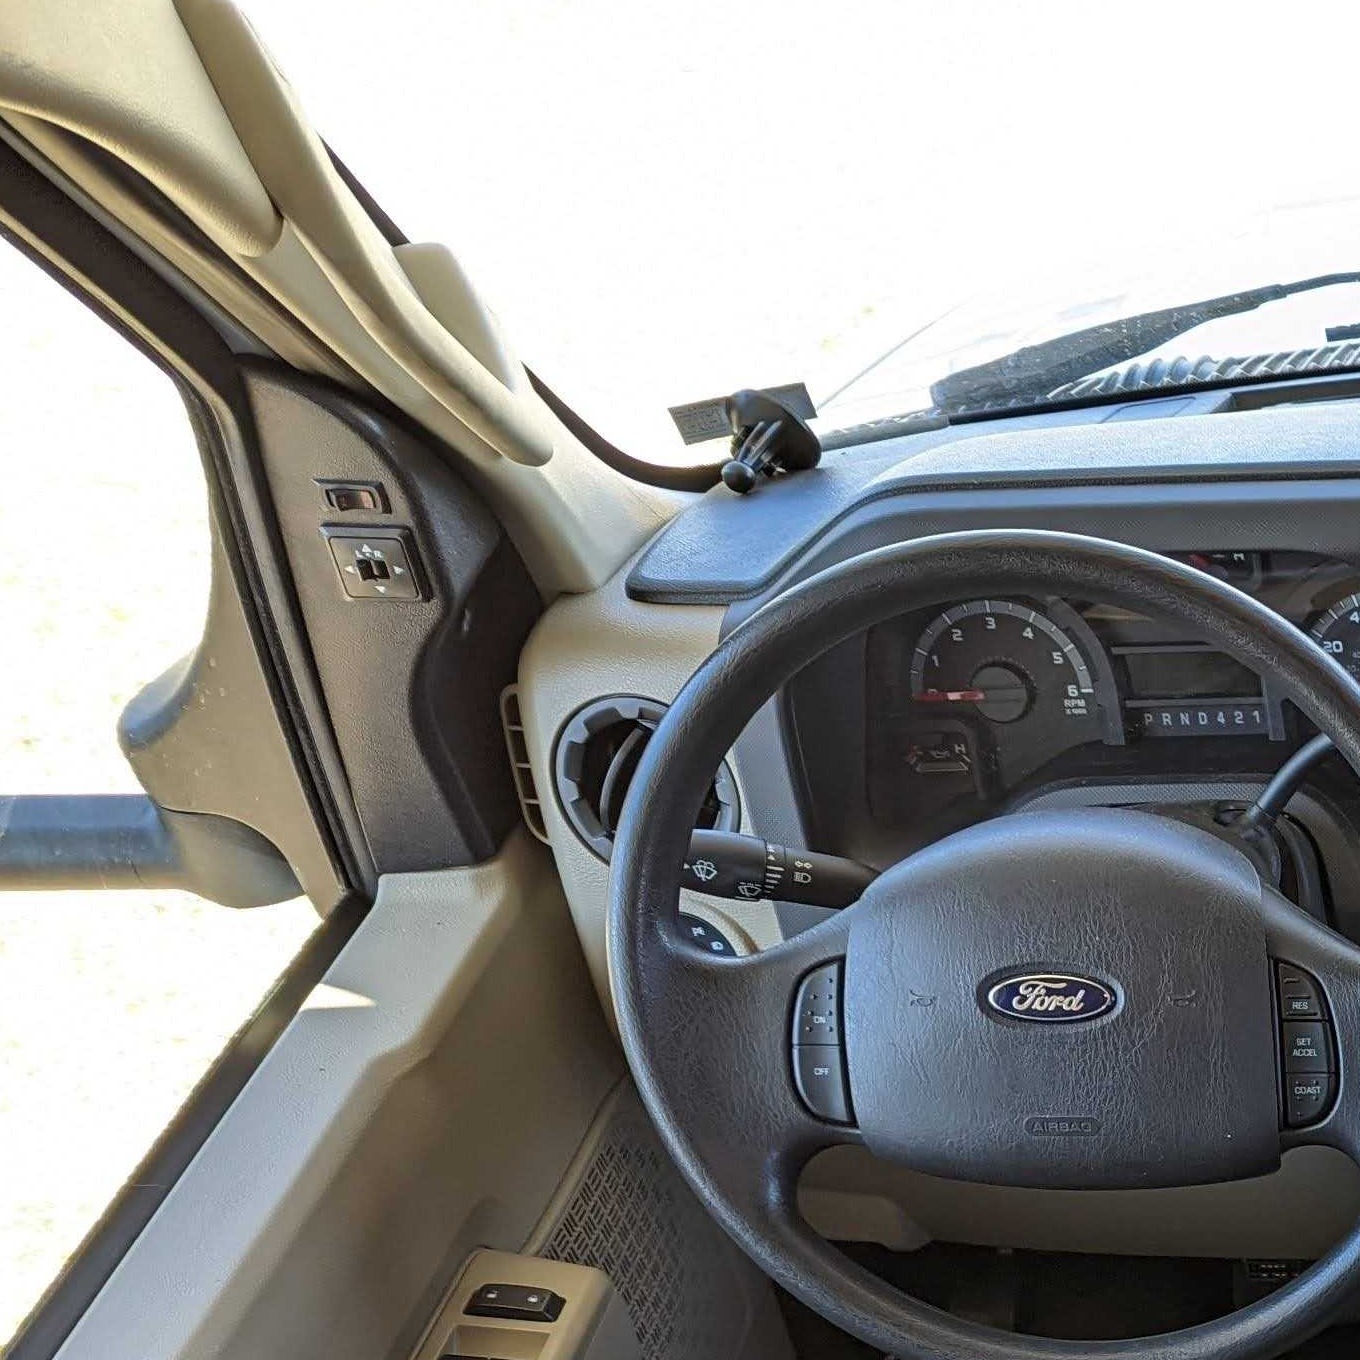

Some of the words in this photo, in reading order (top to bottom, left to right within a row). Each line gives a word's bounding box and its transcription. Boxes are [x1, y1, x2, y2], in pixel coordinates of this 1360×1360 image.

[984, 617, 997, 630] 3
[951, 628, 964, 641] 2
[1022, 627, 1035, 640] 4
[1322, 640, 1344, 654] 20
[930, 655, 940, 668] 1
[1051, 651, 1065, 665] 5
[1067, 684, 1079, 697] 6
[1063, 698, 1087, 708] RPM
[1012, 980, 1086, 1011] Ford
[1292, 1001, 1309, 1010] RES
[813, 1015, 826, 1024] ON
[1296, 1037, 1311, 1046] SET
[1292, 1048, 1318, 1057] ACCEL
[813, 1067, 830, 1076] OFF
[1294, 1086, 1322, 1095] COAST
[1031, 1120, 1093, 1133] AIRBAG
